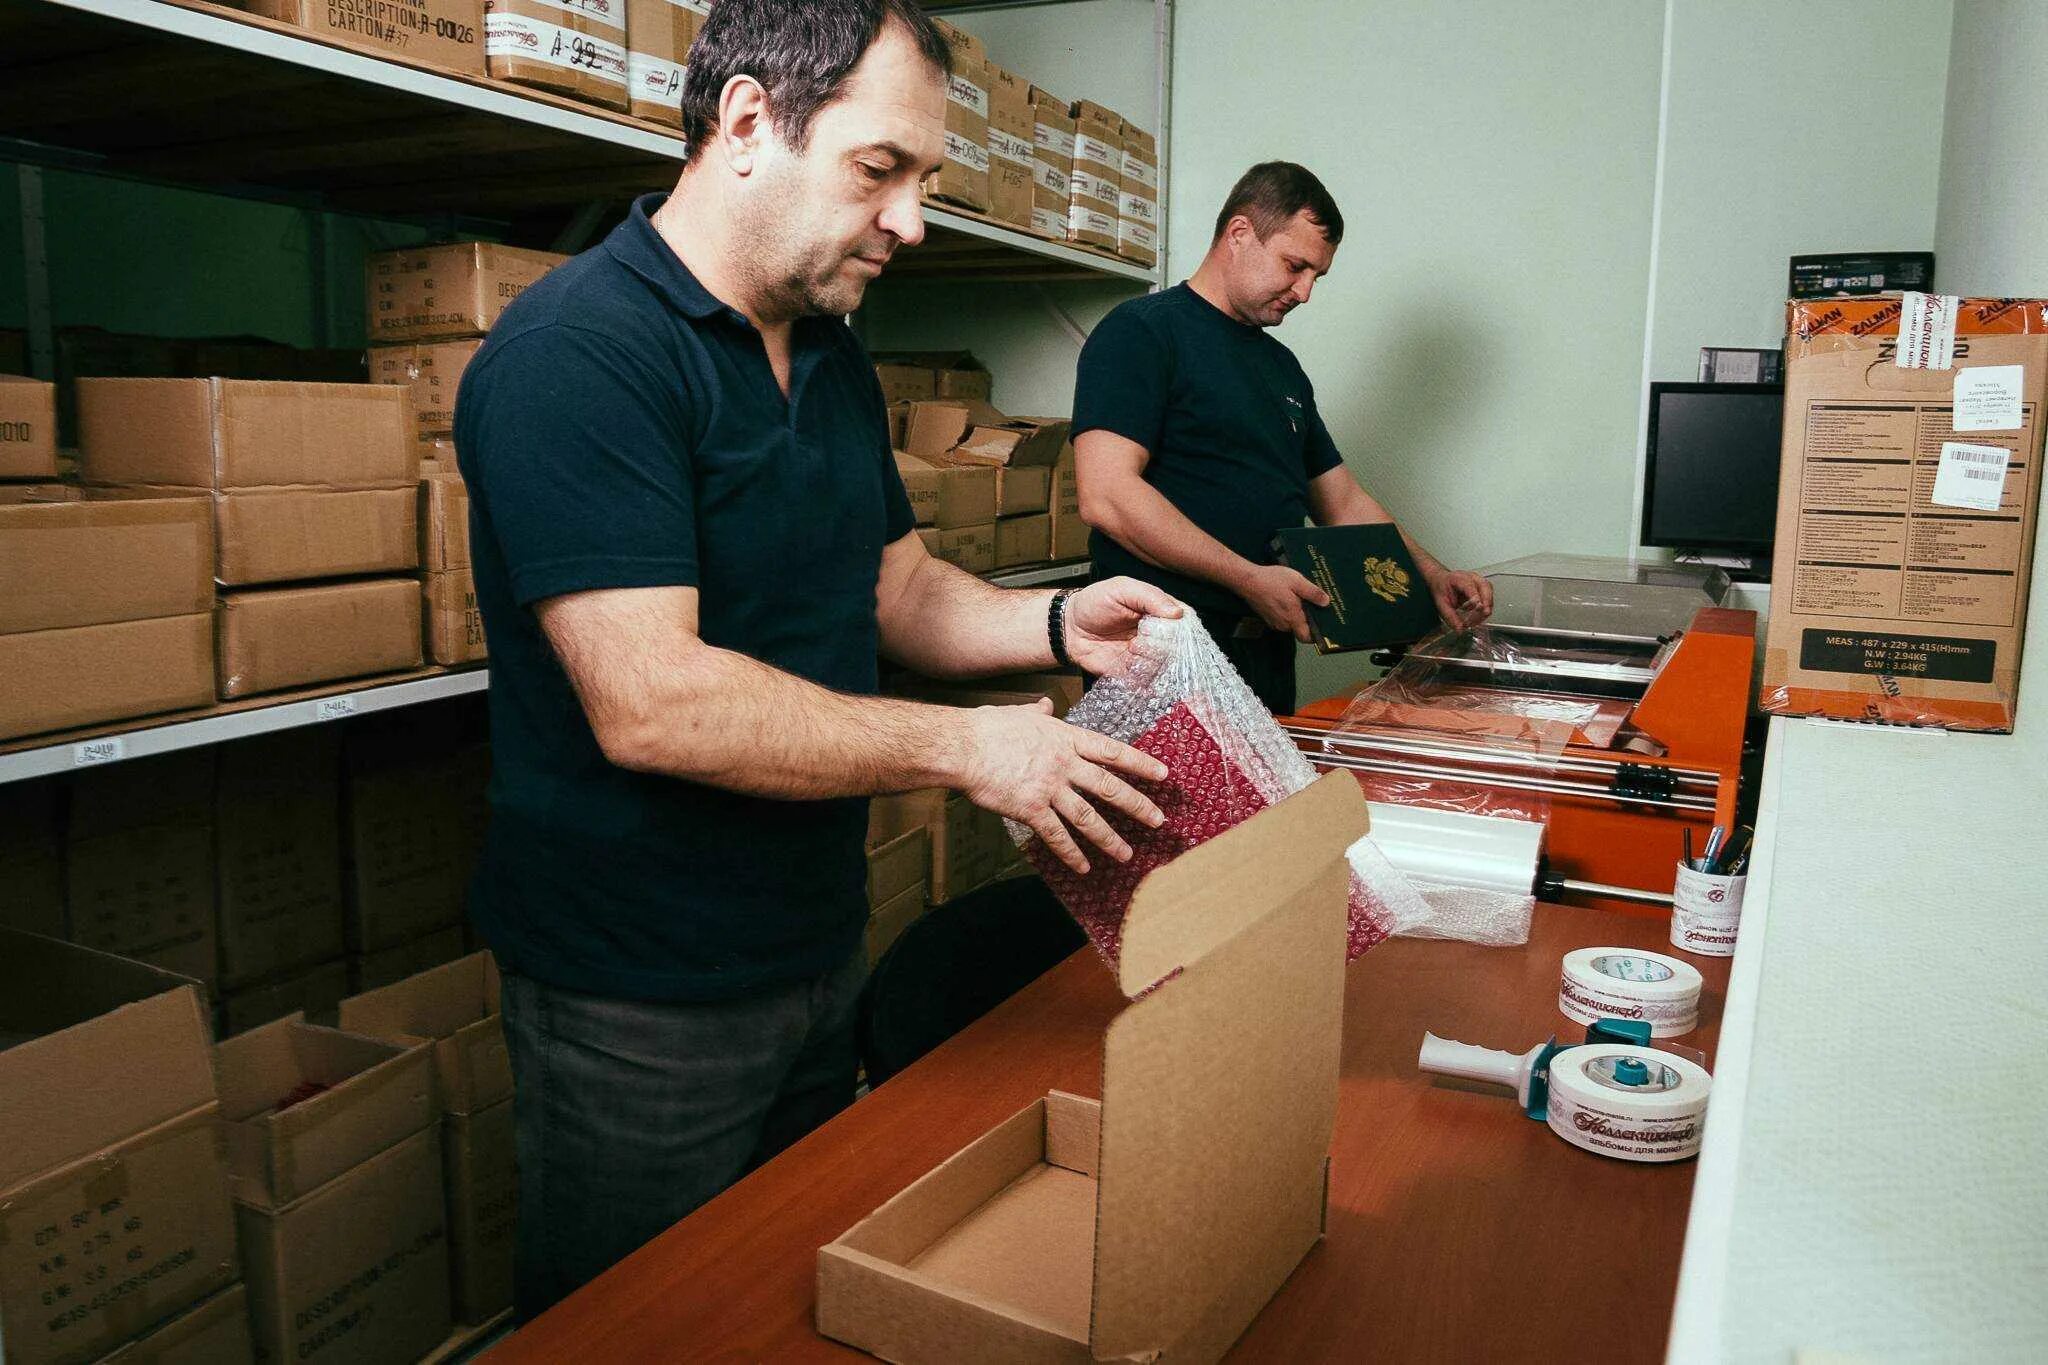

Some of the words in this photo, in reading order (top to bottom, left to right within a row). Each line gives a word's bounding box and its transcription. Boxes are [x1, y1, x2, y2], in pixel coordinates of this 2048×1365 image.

[1825, 637, 1853, 646] MEAS
[1861, 640, 1879, 648] 487
[1890, 641, 1908, 650] 229
[1588, 1137, 1633, 1153] альбомы
[1634, 1145, 1654, 1154] для
